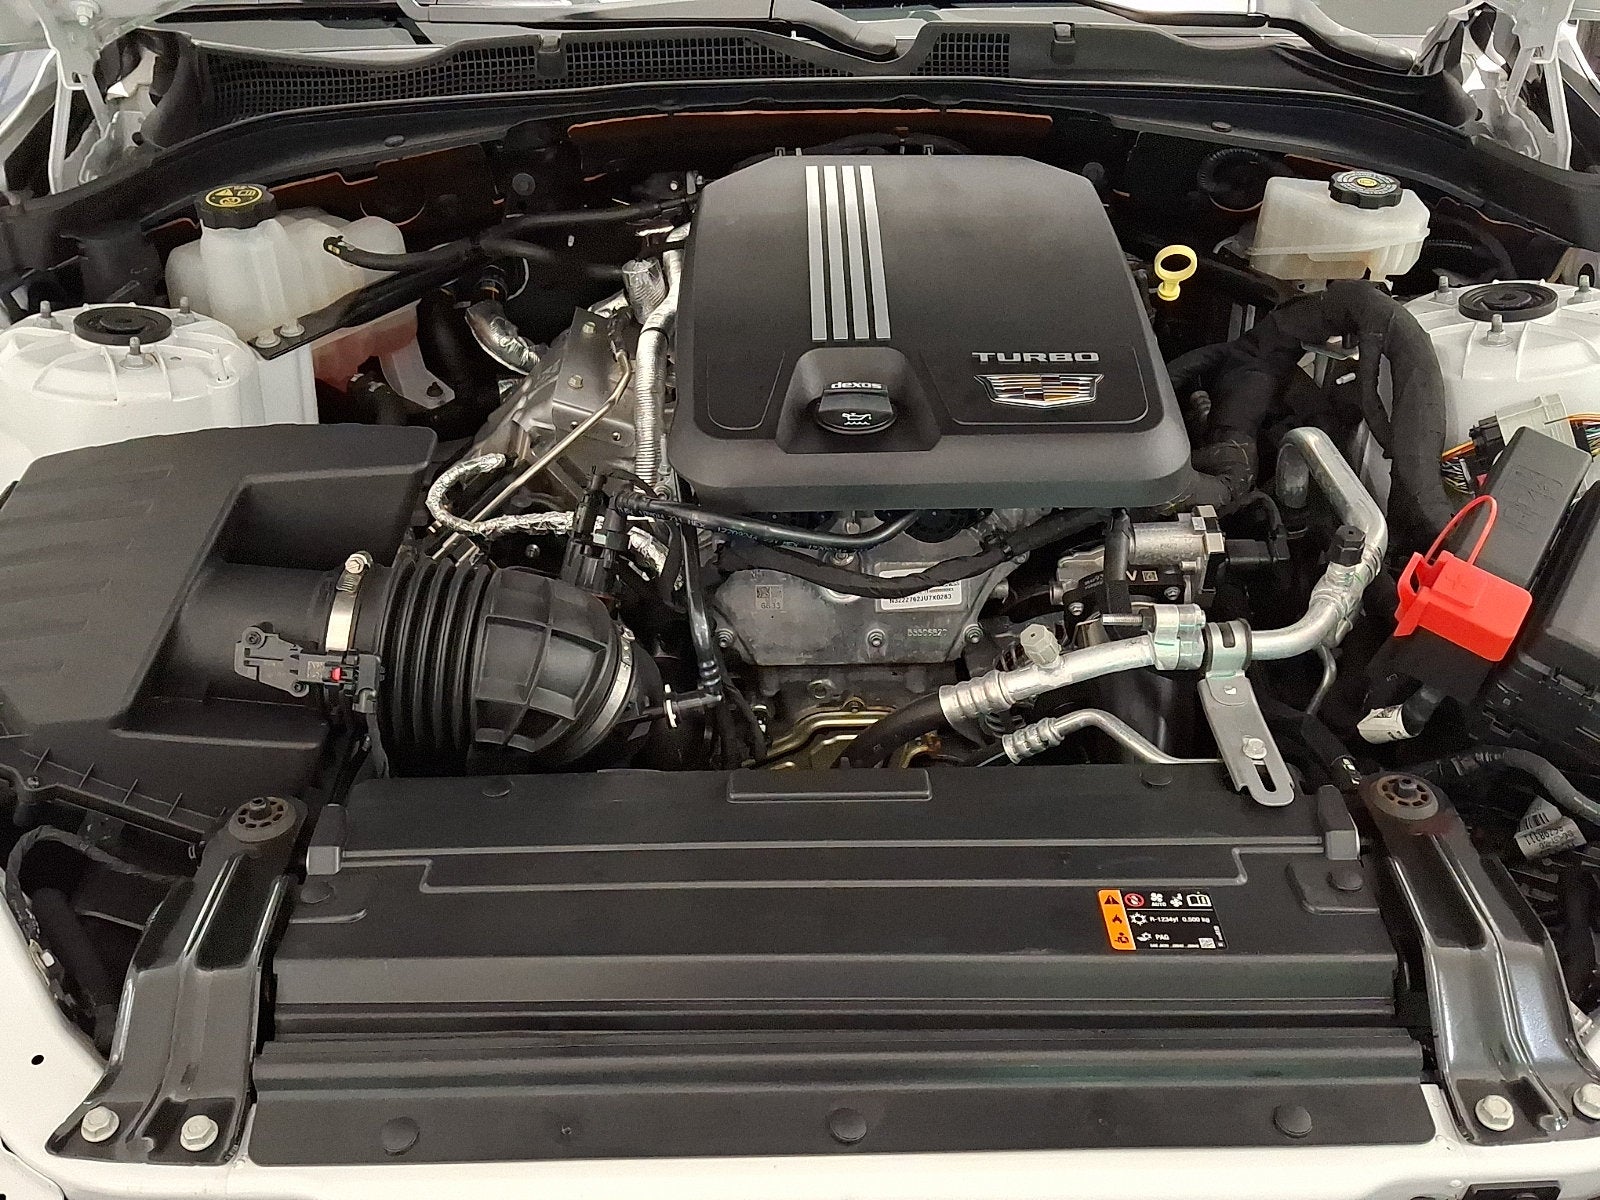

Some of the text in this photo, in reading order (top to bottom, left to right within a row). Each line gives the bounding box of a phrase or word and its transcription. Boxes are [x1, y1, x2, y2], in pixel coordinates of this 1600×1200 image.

[971, 351, 1099, 363] TURBO
[830, 381, 882, 389] dexos
[1201, 916, 1211, 924] kg
[1154, 933, 1170, 941] PAG
